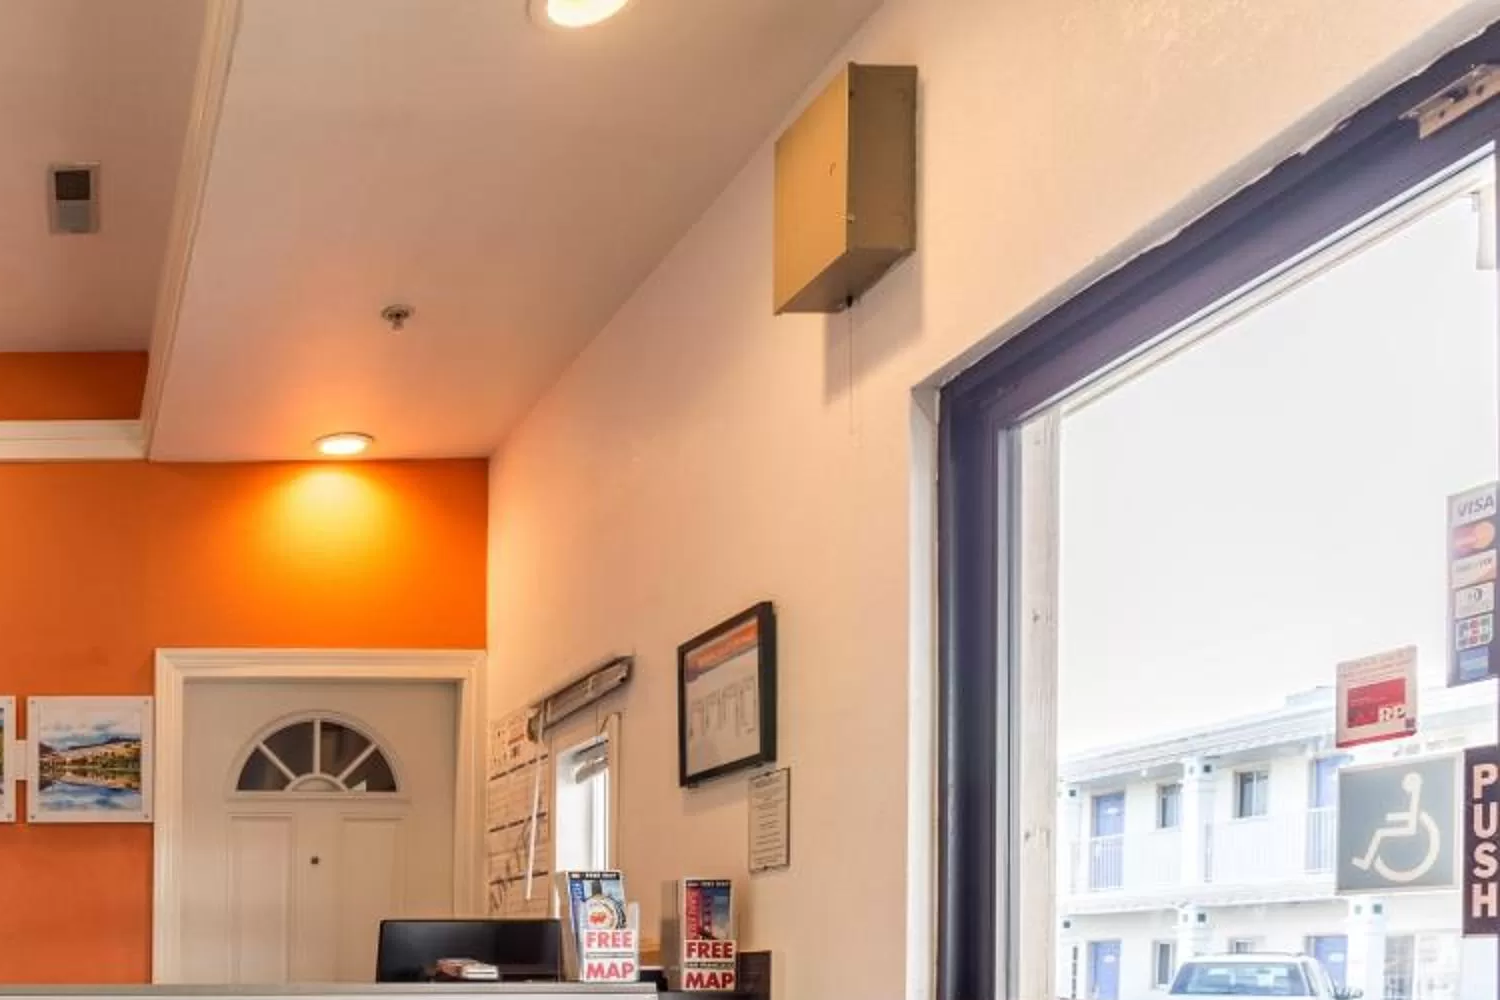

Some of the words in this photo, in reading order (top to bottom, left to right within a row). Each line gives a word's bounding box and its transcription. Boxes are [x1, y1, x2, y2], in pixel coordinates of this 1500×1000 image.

[1457, 495, 1494, 517] VISA
[1472, 763, 1499, 918] PUSH
[586, 931, 632, 948] FREE
[686, 942, 733, 958] FREE
[586, 962, 634, 979] MAP
[686, 972, 733, 988] MAP
